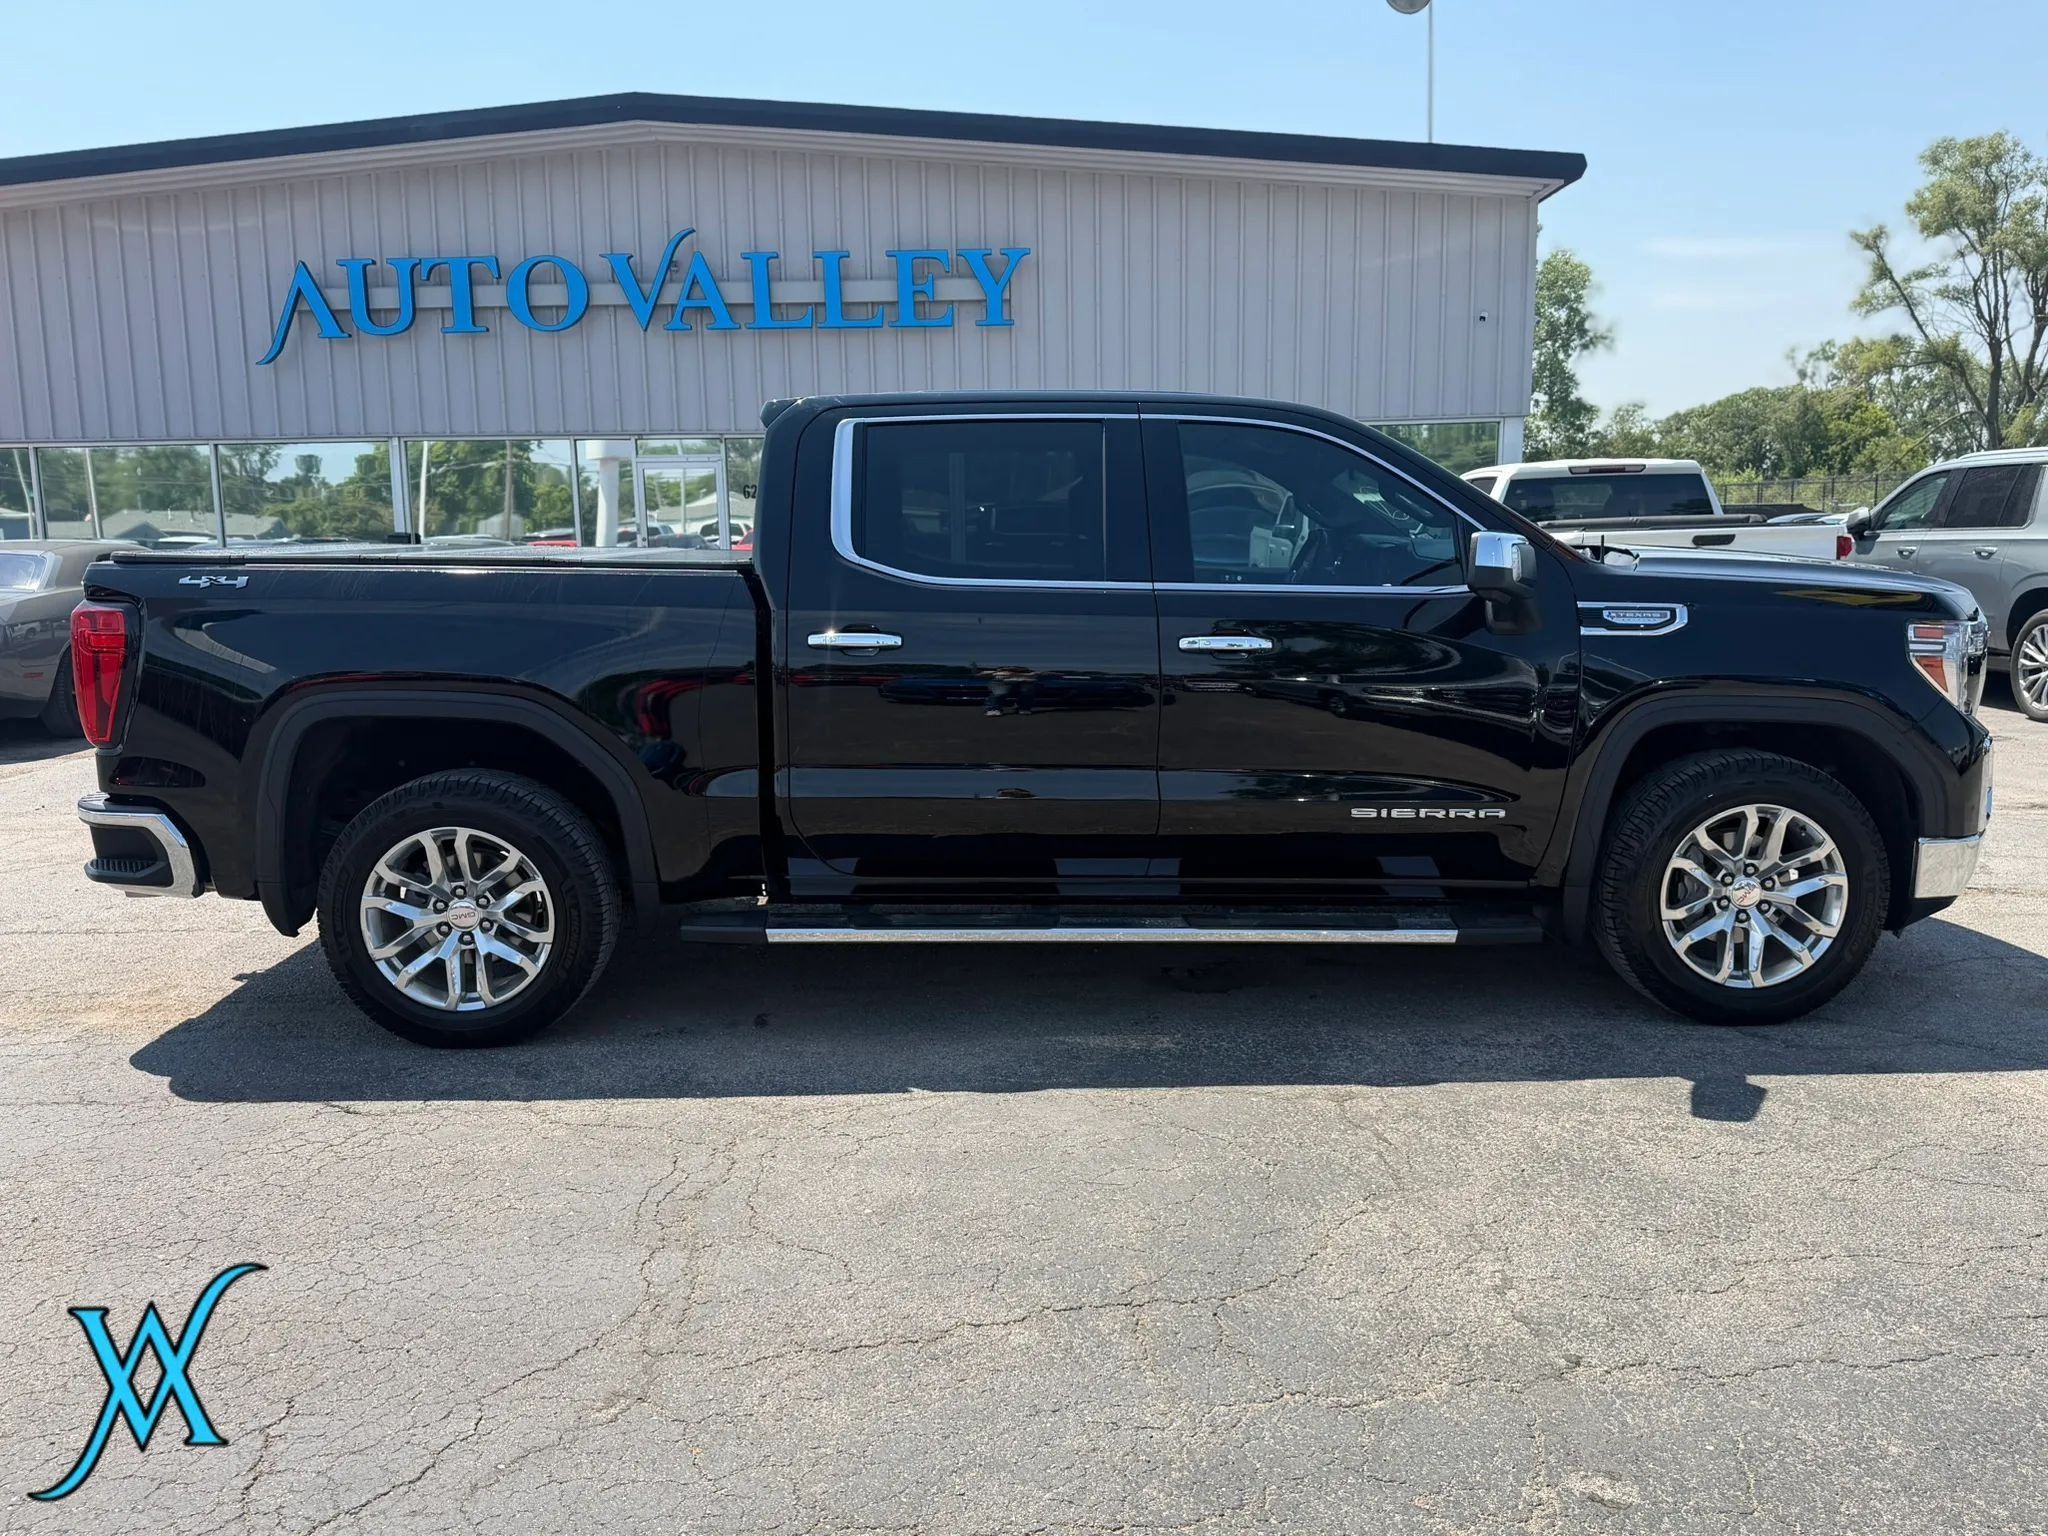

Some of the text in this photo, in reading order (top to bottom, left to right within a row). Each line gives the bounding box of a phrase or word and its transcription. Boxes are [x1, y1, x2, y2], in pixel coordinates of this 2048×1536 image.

[256, 227, 1032, 367] AUTO VALLEY
[1350, 807, 1506, 819] SIERRA
[450, 911, 476, 921] GMC
